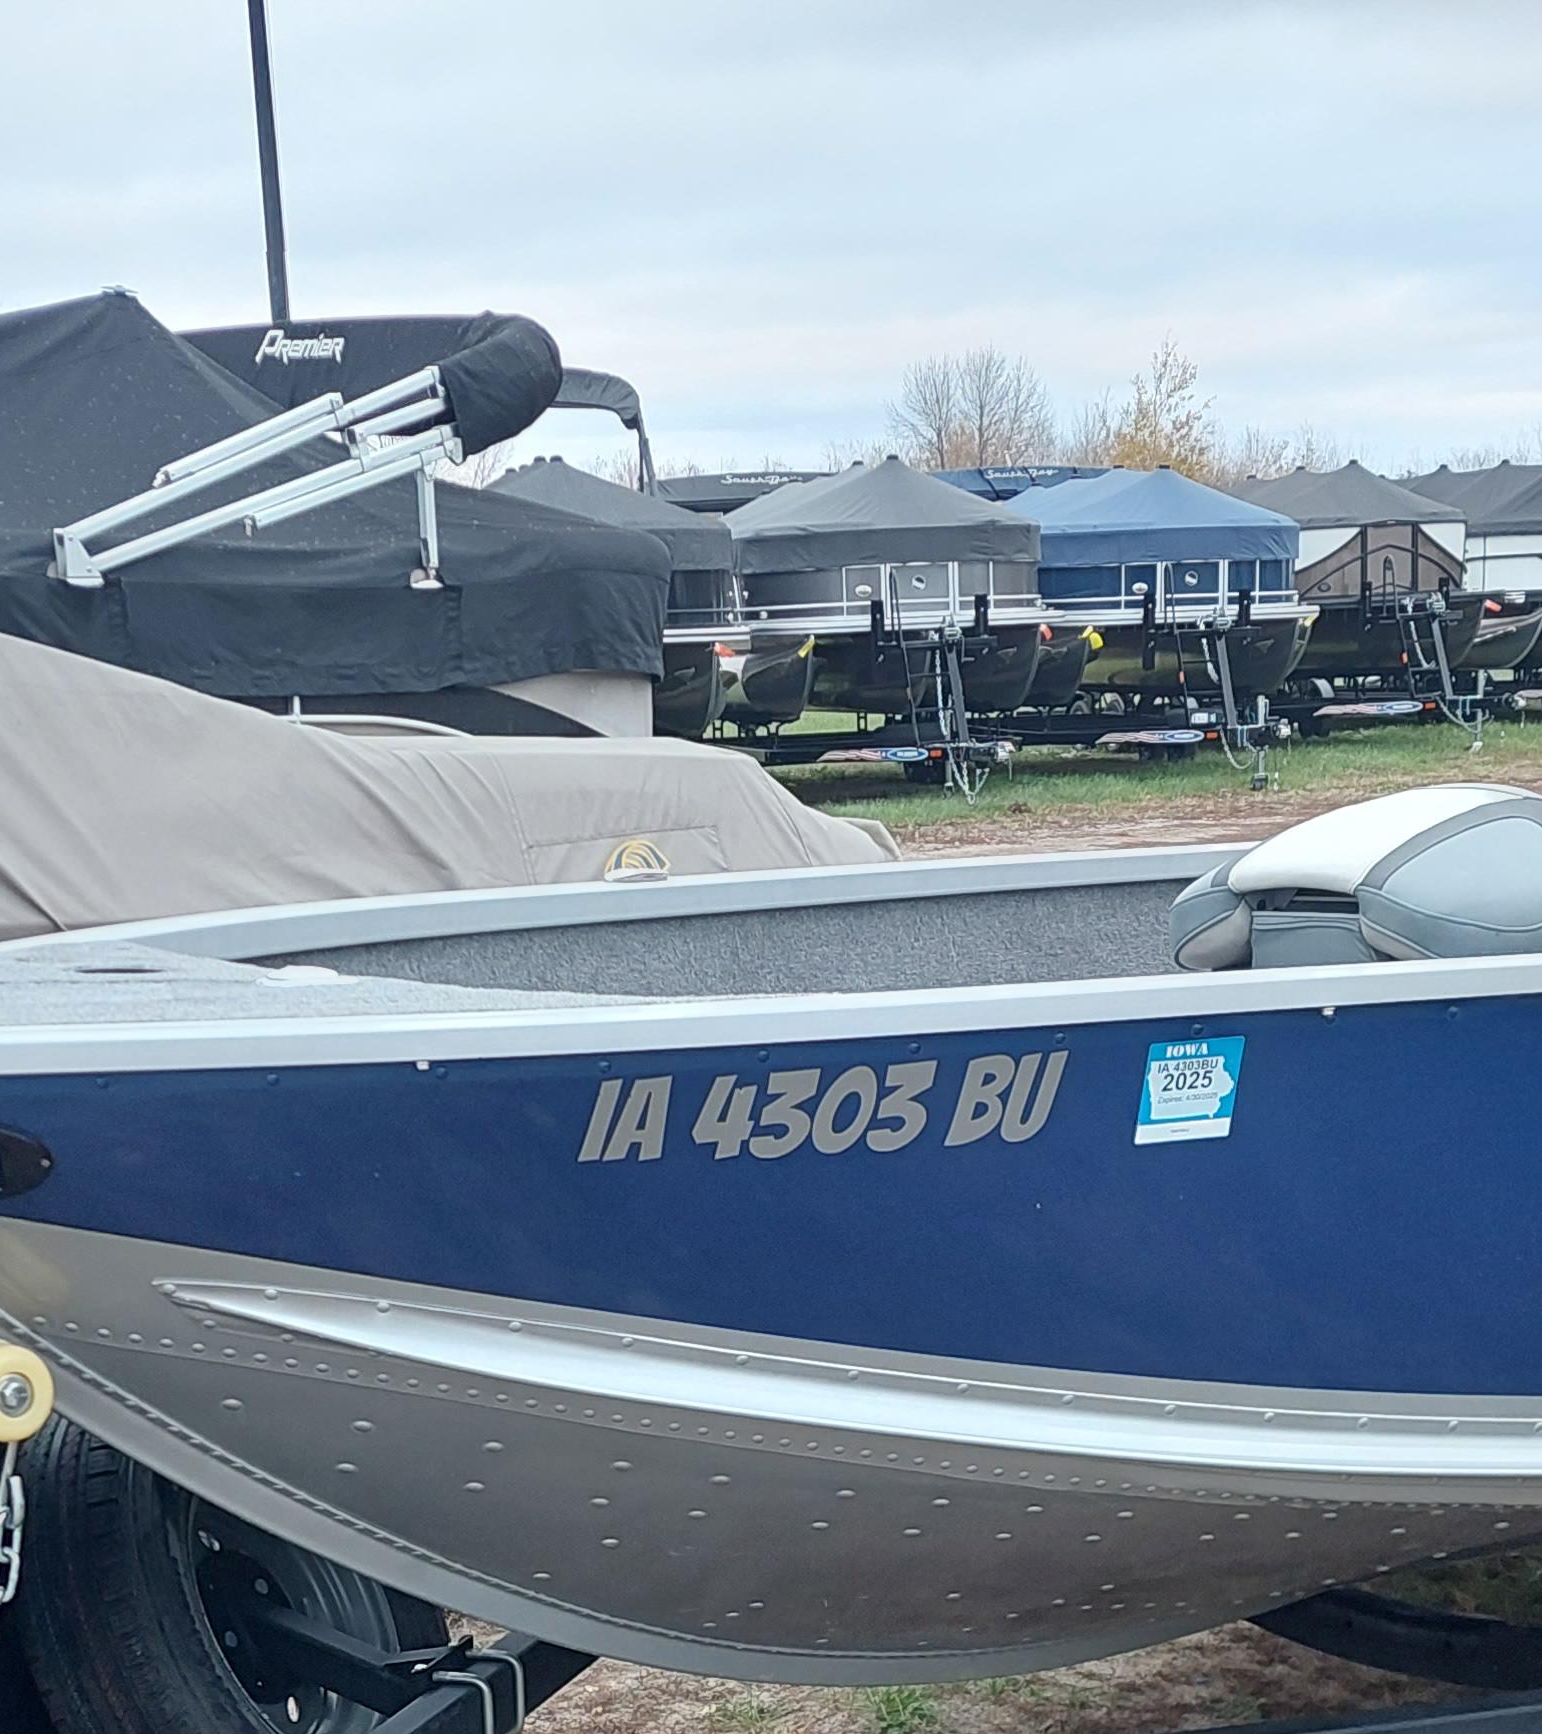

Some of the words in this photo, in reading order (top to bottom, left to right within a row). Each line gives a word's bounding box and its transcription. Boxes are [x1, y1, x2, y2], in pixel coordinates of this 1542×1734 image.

[1165, 1042, 1209, 1058] IOWA
[1157, 1063, 1170, 1074] IA
[1173, 1058, 1219, 1073] 4303BU
[1161, 1070, 1214, 1092] 2025
[577, 1075, 673, 1163] IA
[691, 1060, 939, 1161] 4303
[944, 1050, 1070, 1147] BU
